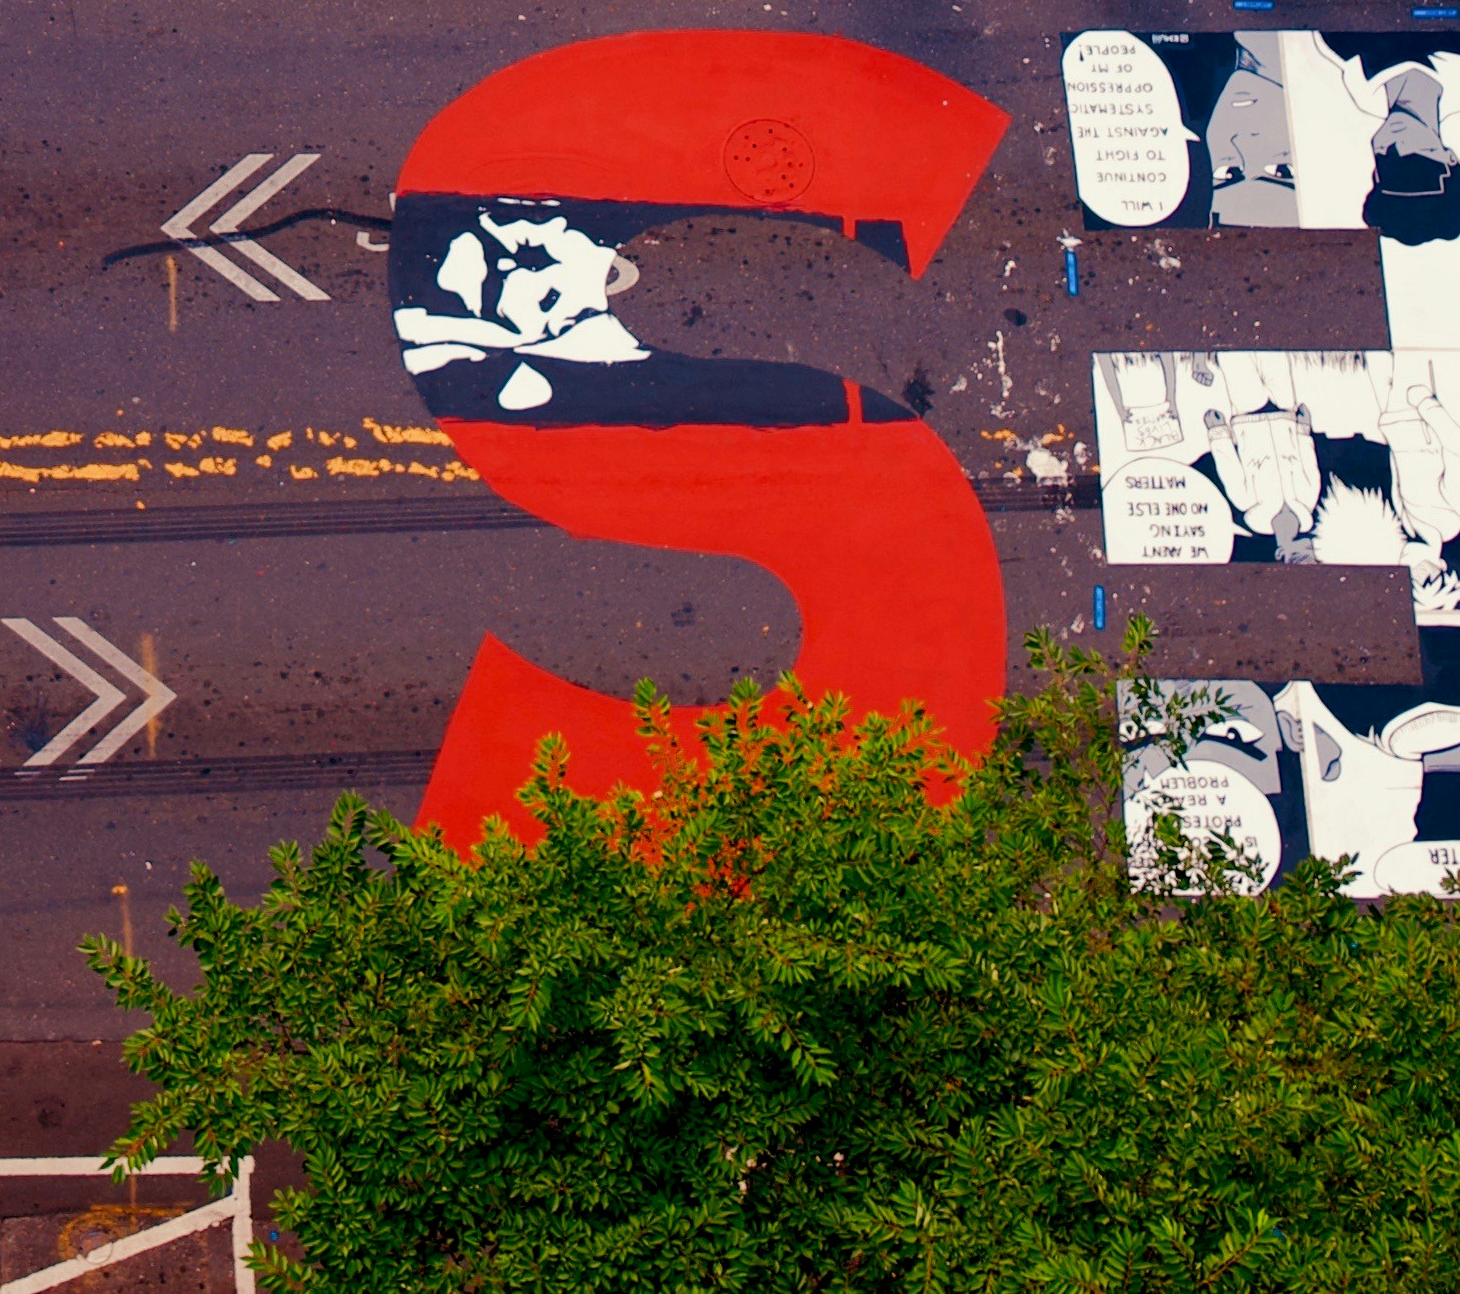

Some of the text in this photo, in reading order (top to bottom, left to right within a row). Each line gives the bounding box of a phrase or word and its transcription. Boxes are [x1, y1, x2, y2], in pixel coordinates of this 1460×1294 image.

[1078, 45, 1135, 62] PEOPLE!
[1091, 64, 1132, 73] OF MY
[1067, 82, 1153, 93] OPPRESSION
[1069, 104, 1153, 114] SYSTEMATIC
[1077, 127, 1168, 138] AGAINST THE
[1096, 150, 1165, 161] TO FIGHT
[1096, 172, 1166, 182] CONTINUE
[1121, 201, 1152, 211] WILL
[1125, 476, 1186, 489] MATTERS
[1127, 502, 1208, 516] NO ONE ELSE
[1150, 524, 1205, 537] SAYING
[1191, 547, 1208, 558] WE
[1161, 777, 1229, 789] PROBLEM
[1217, 795, 1226, 805] A
